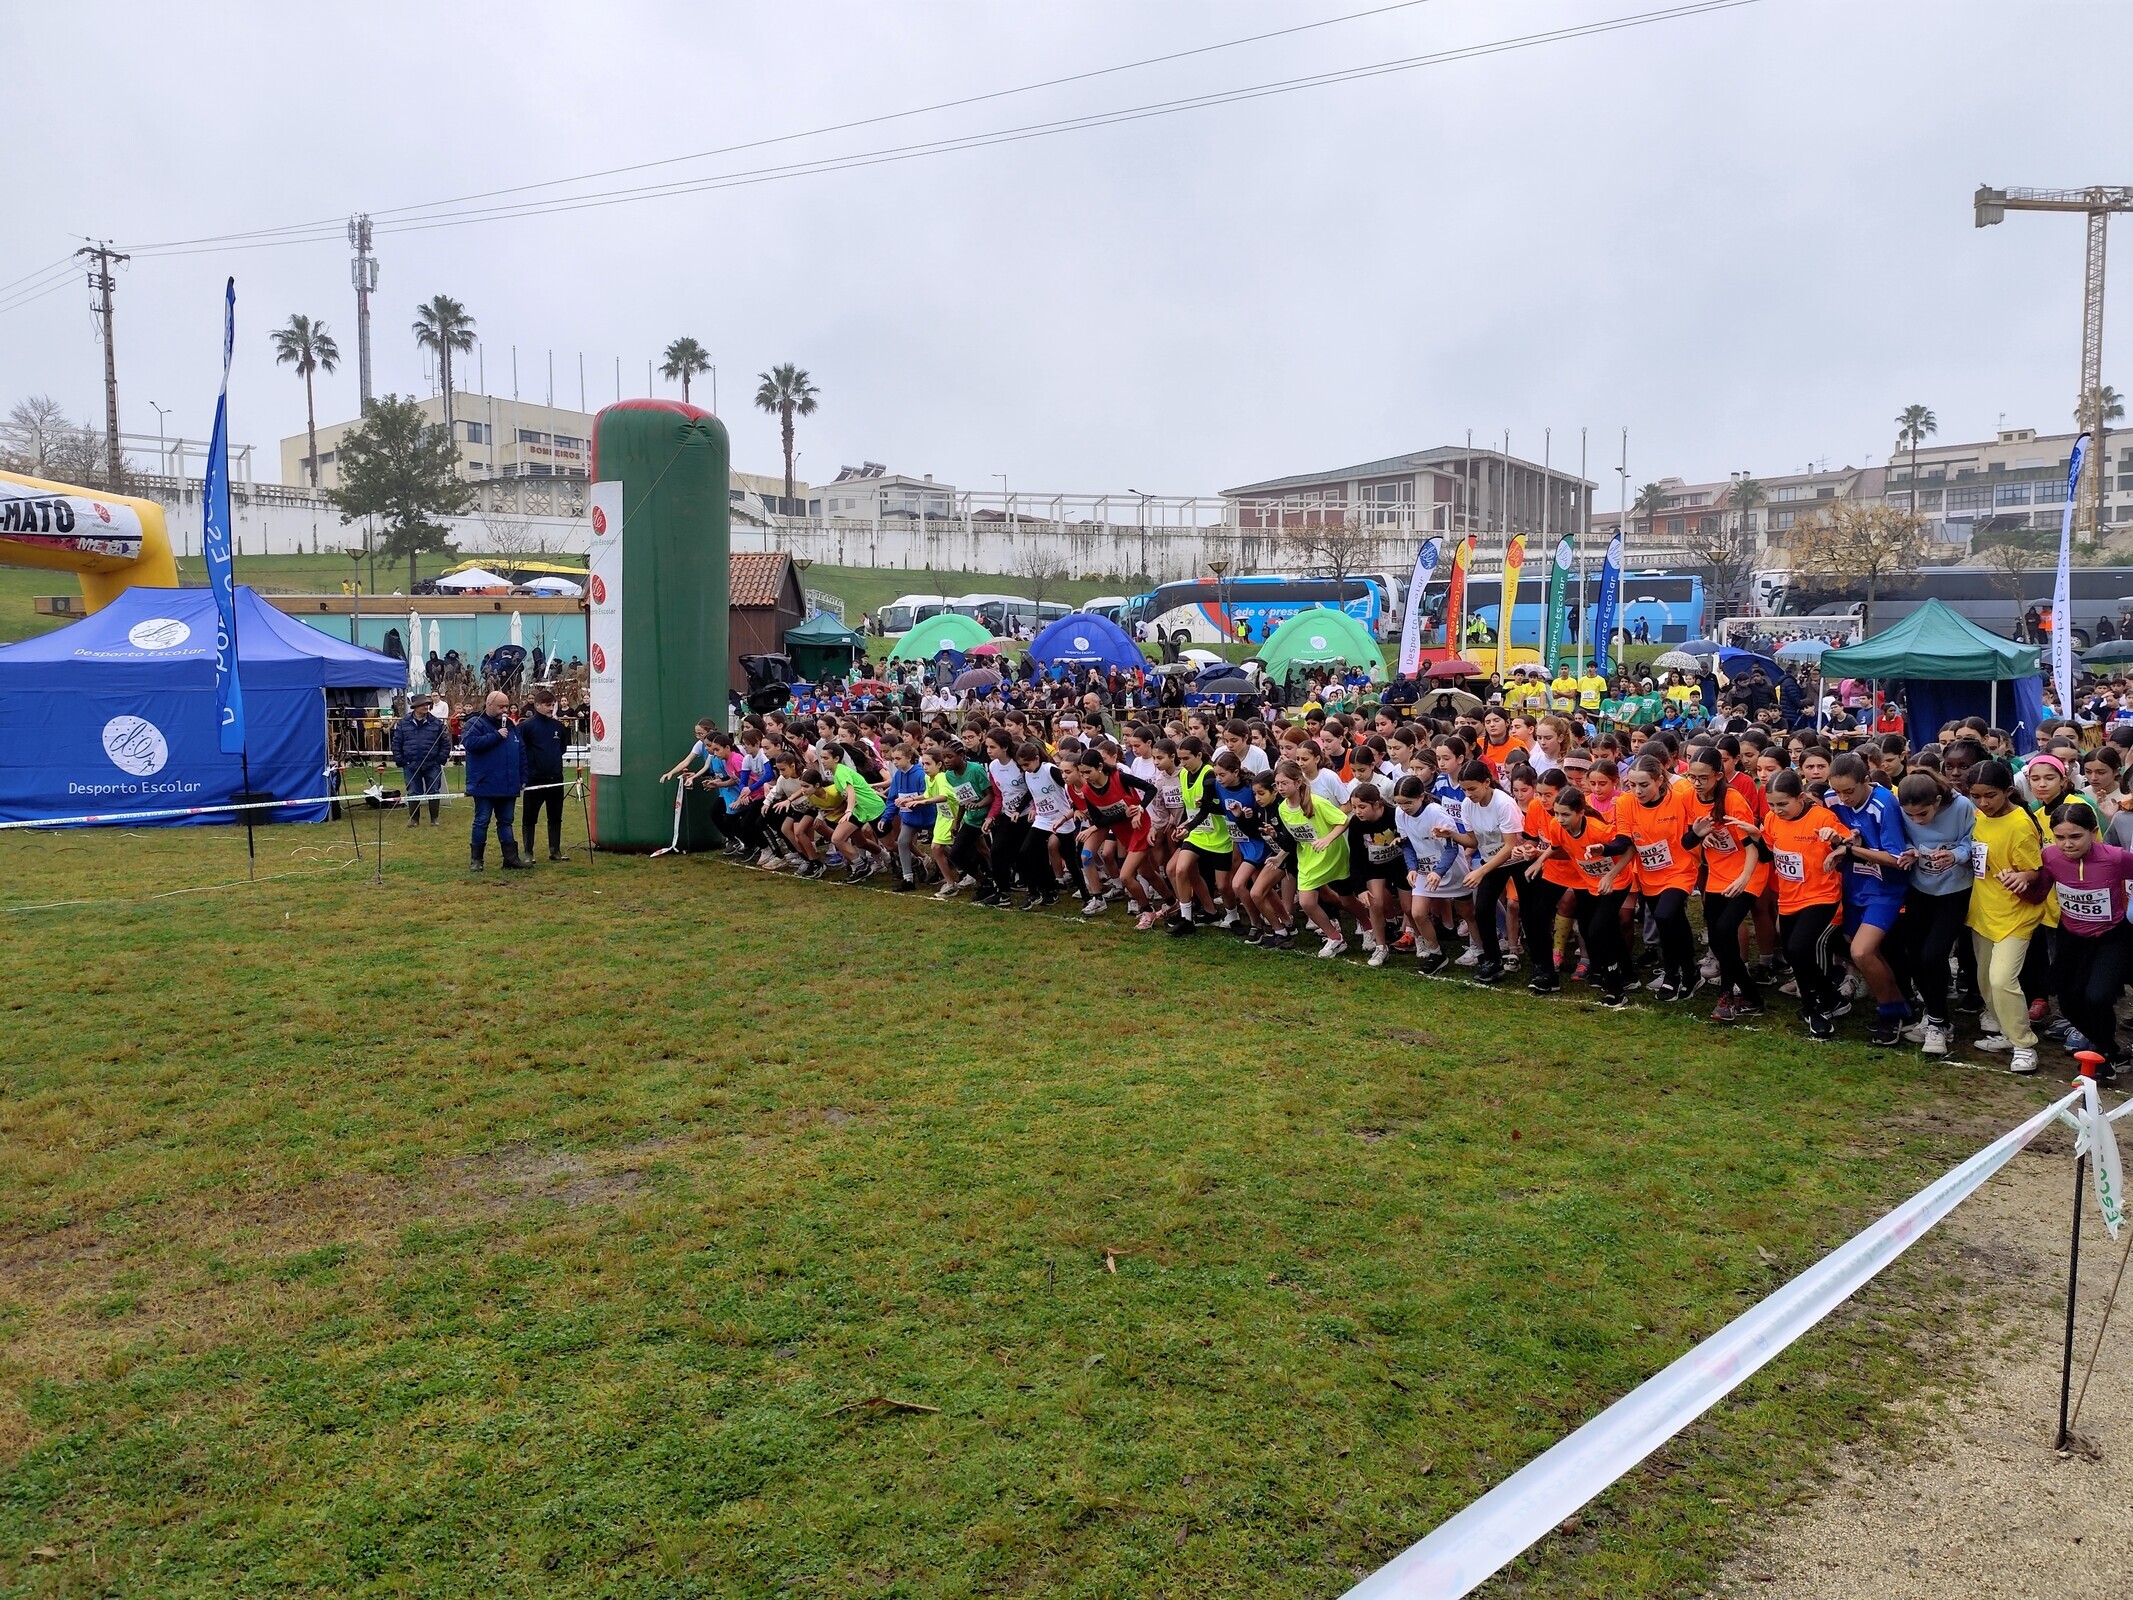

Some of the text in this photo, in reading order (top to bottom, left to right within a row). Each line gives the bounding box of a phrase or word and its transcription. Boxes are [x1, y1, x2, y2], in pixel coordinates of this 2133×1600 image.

[530, 446, 580, 460] BOMEIROS
[1603, 576, 1617, 618] Escolar
[1230, 604, 1255, 616] Rede
[74, 648, 206, 658] Desporto Escolar
[69, 780, 201, 796] Desporto Escolar
[2063, 901, 2103, 915] 4458
